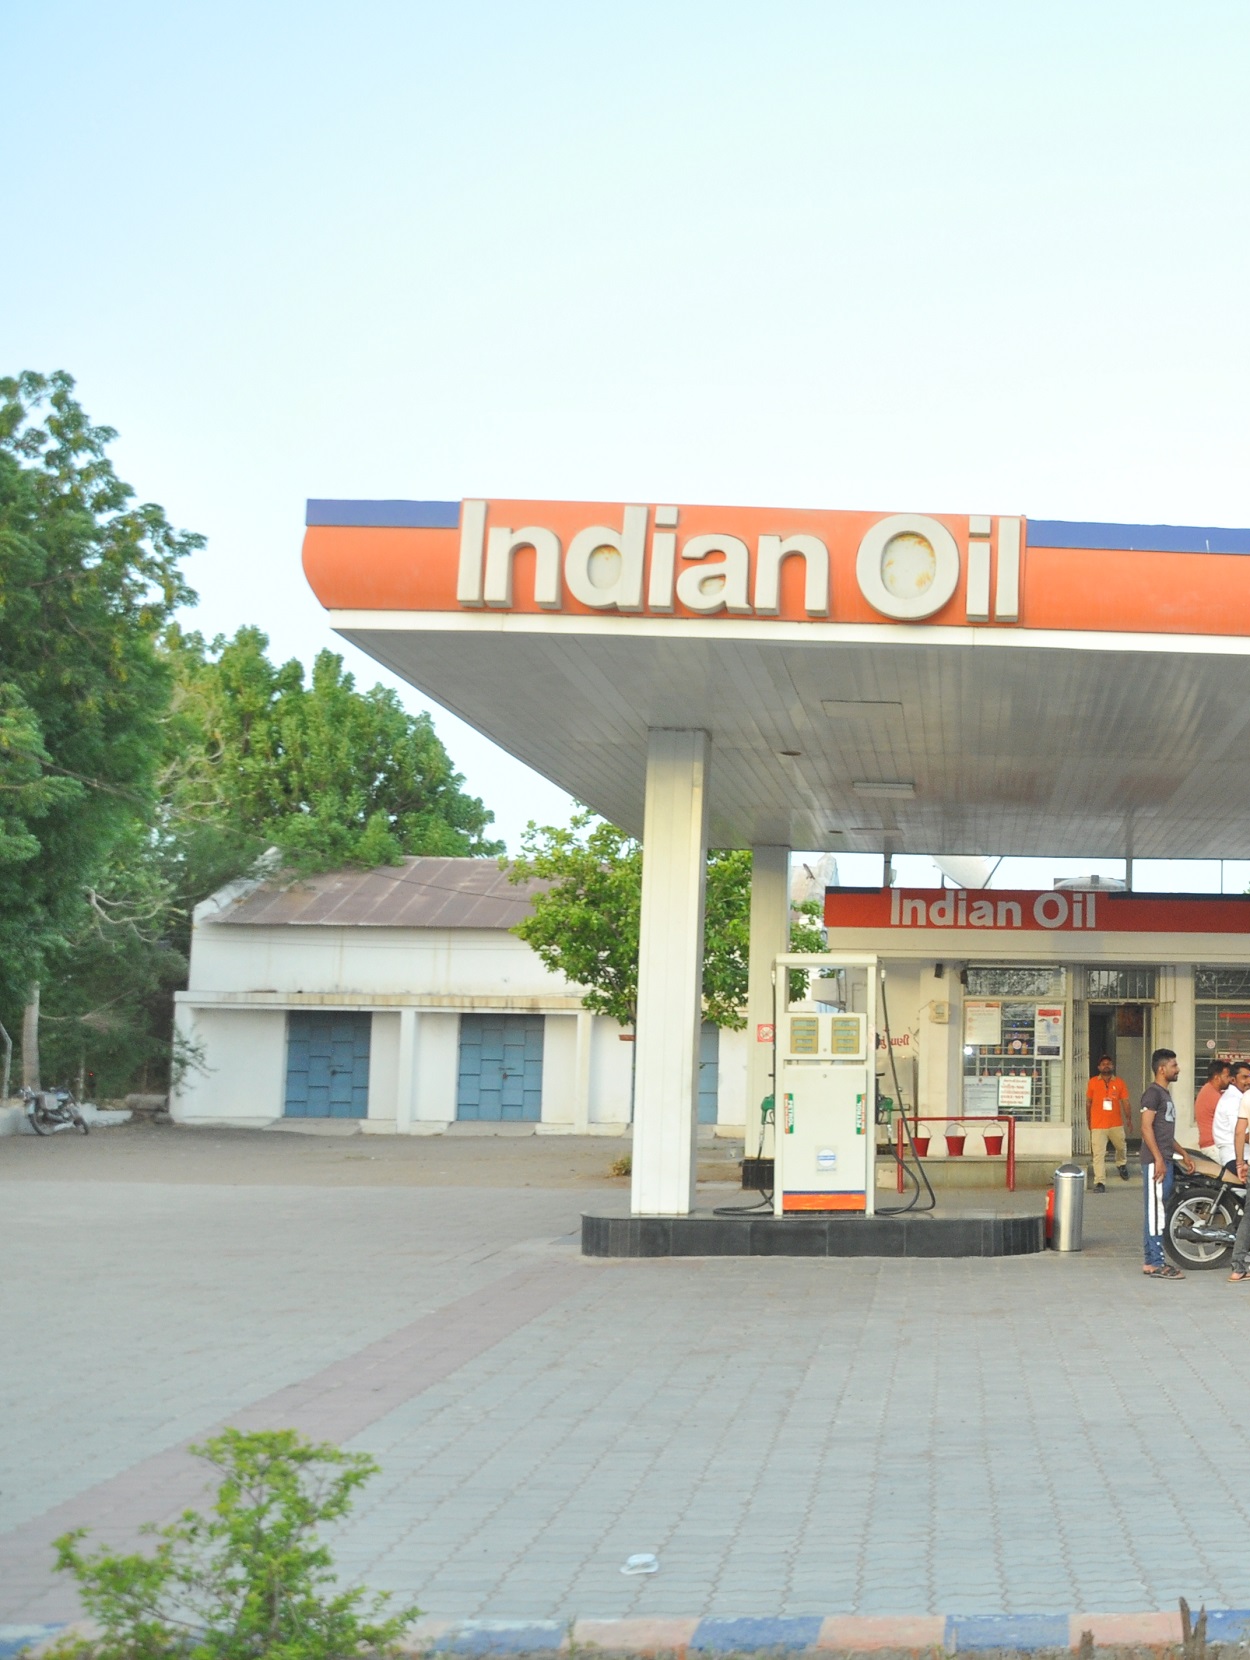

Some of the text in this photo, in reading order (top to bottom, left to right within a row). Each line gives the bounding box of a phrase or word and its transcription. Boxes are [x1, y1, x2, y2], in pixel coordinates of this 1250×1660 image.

[456, 500, 1022, 622] Indian Oil
[890, 889, 1096, 928] Indian Oil
